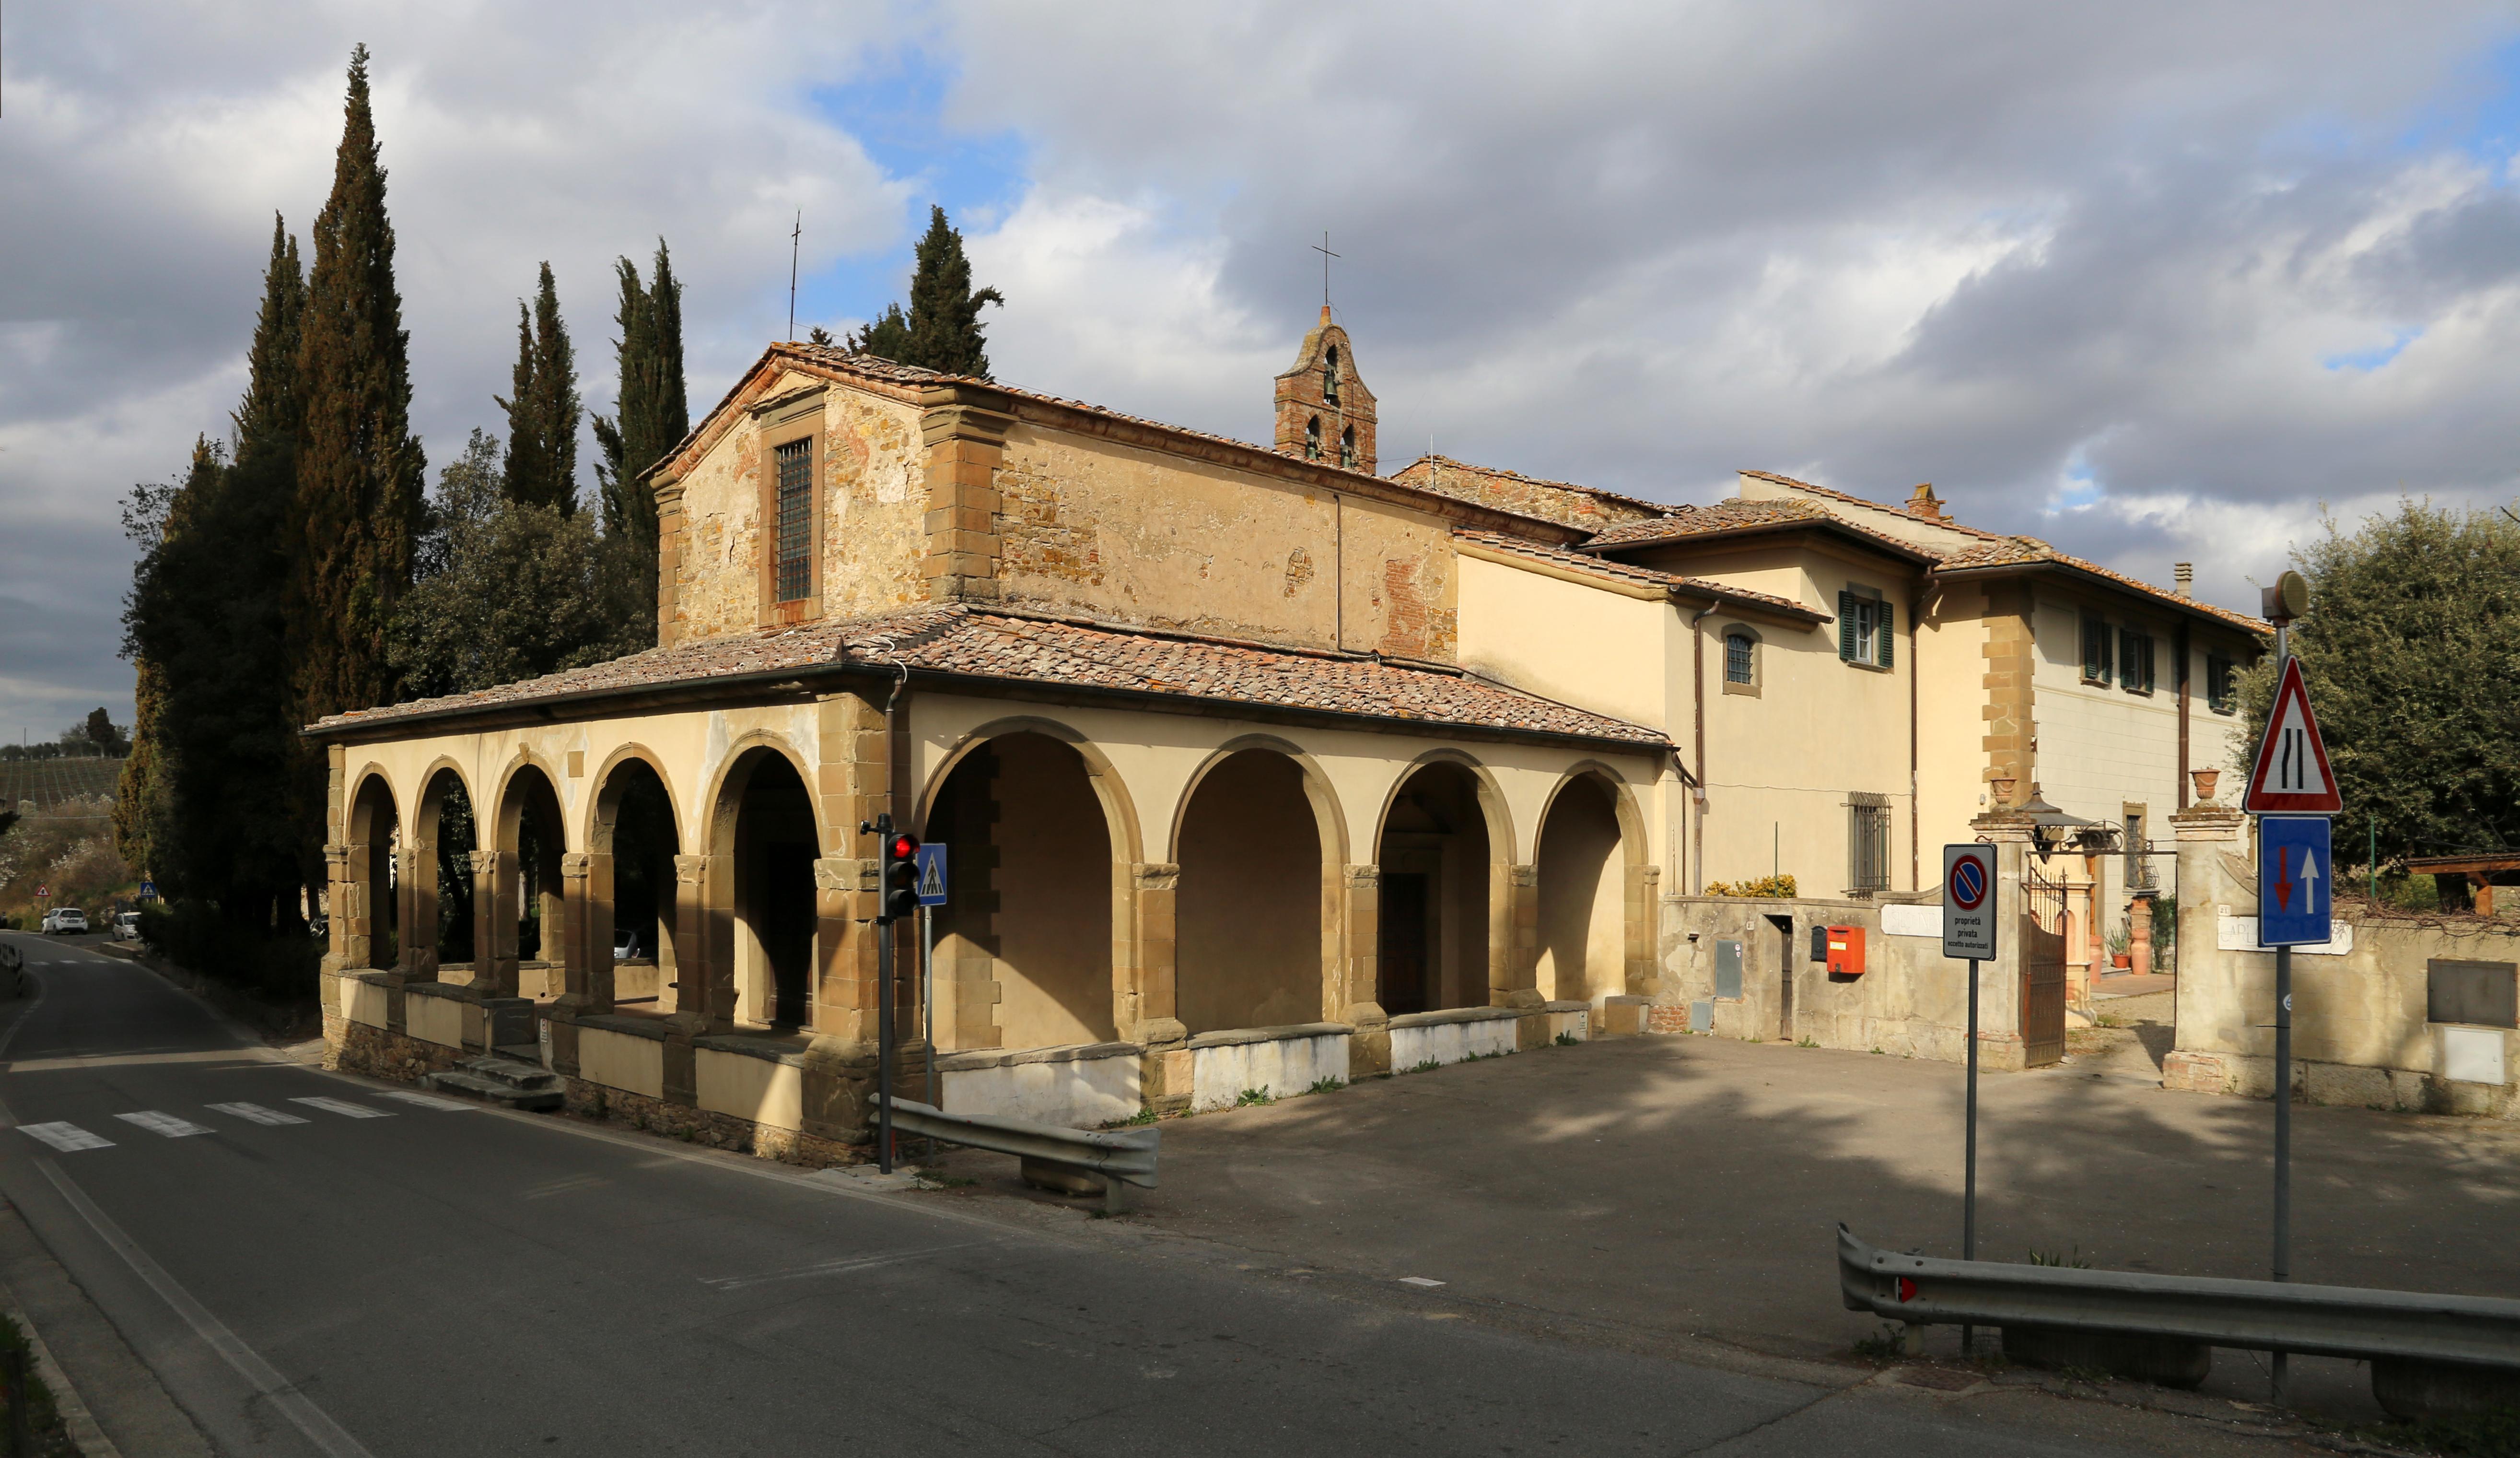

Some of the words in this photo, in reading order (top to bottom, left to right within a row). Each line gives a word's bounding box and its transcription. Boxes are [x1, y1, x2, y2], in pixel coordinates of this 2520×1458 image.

[1955, 916, 1981, 926] proprietà
[1958, 928, 1977, 938] privata
[2220, 924, 2256, 943] CARL
